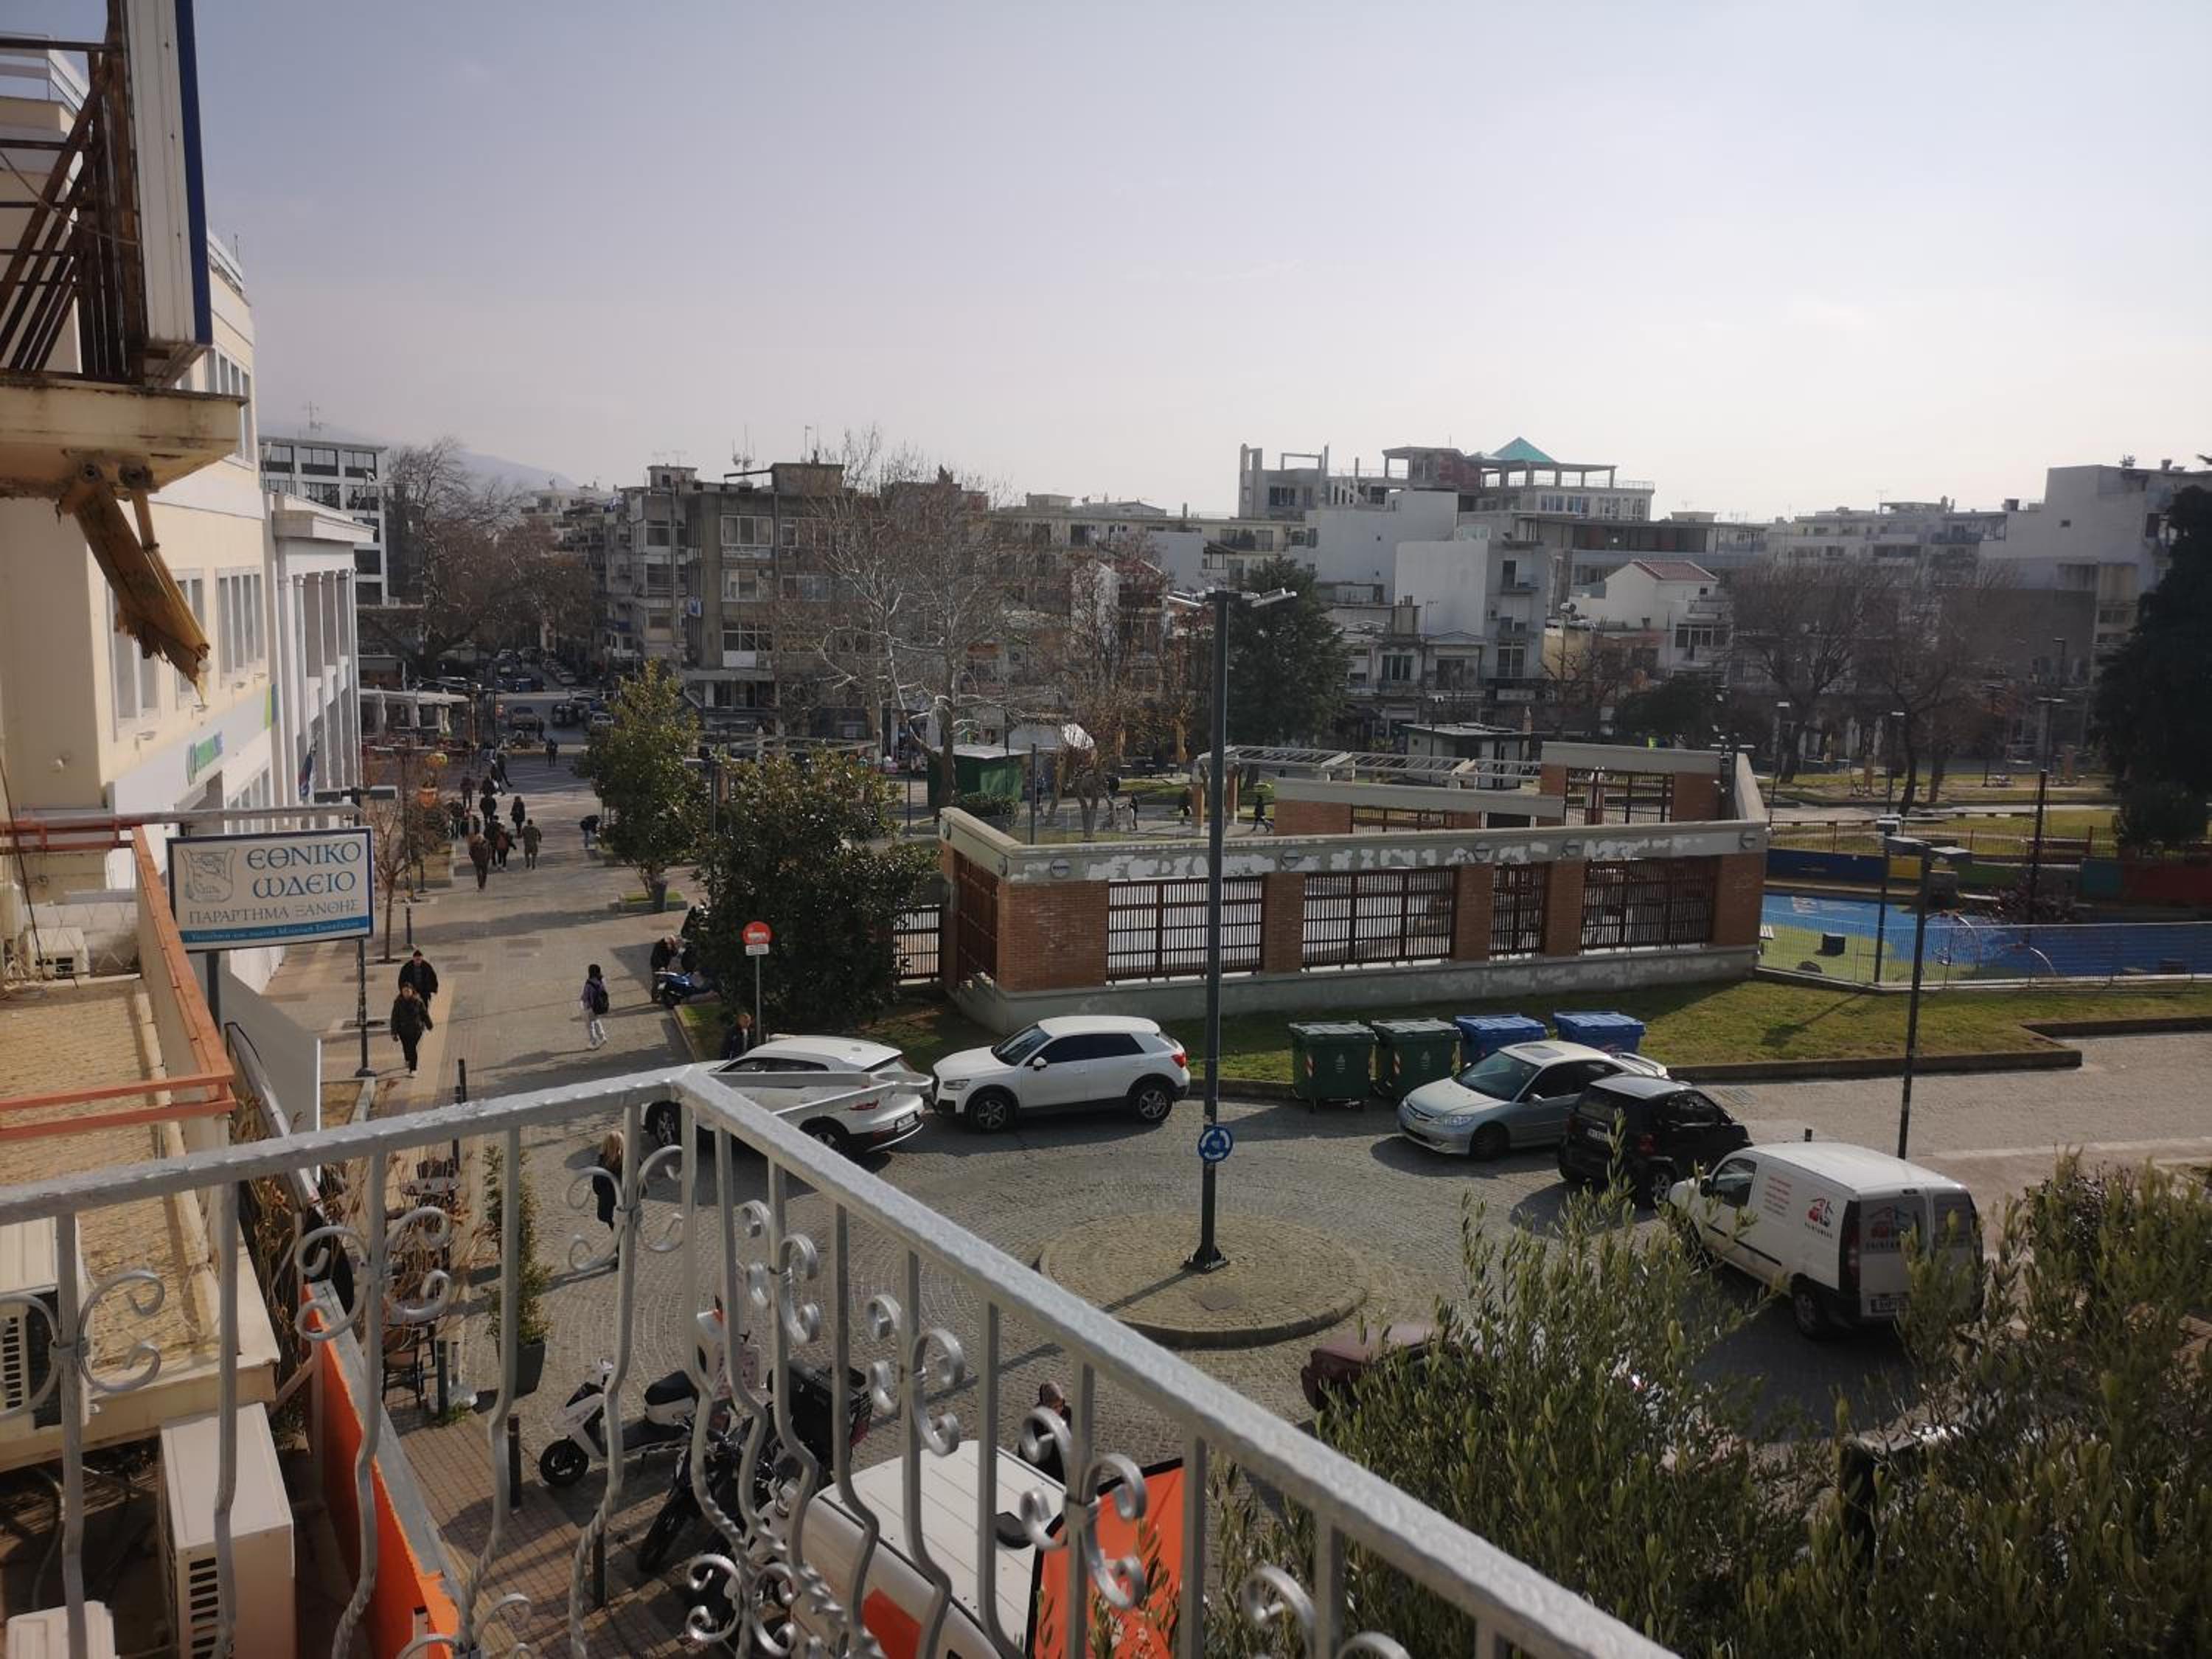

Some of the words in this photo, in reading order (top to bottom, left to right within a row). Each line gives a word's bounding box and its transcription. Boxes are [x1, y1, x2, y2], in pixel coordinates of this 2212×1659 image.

[247, 841, 361, 870] ΕΘΝΙΚΟ
[189, 906, 290, 924] ΠΑΡΑΡΤΗΜΑ
[294, 899, 359, 917] ΞΑΝΘΗΣ
